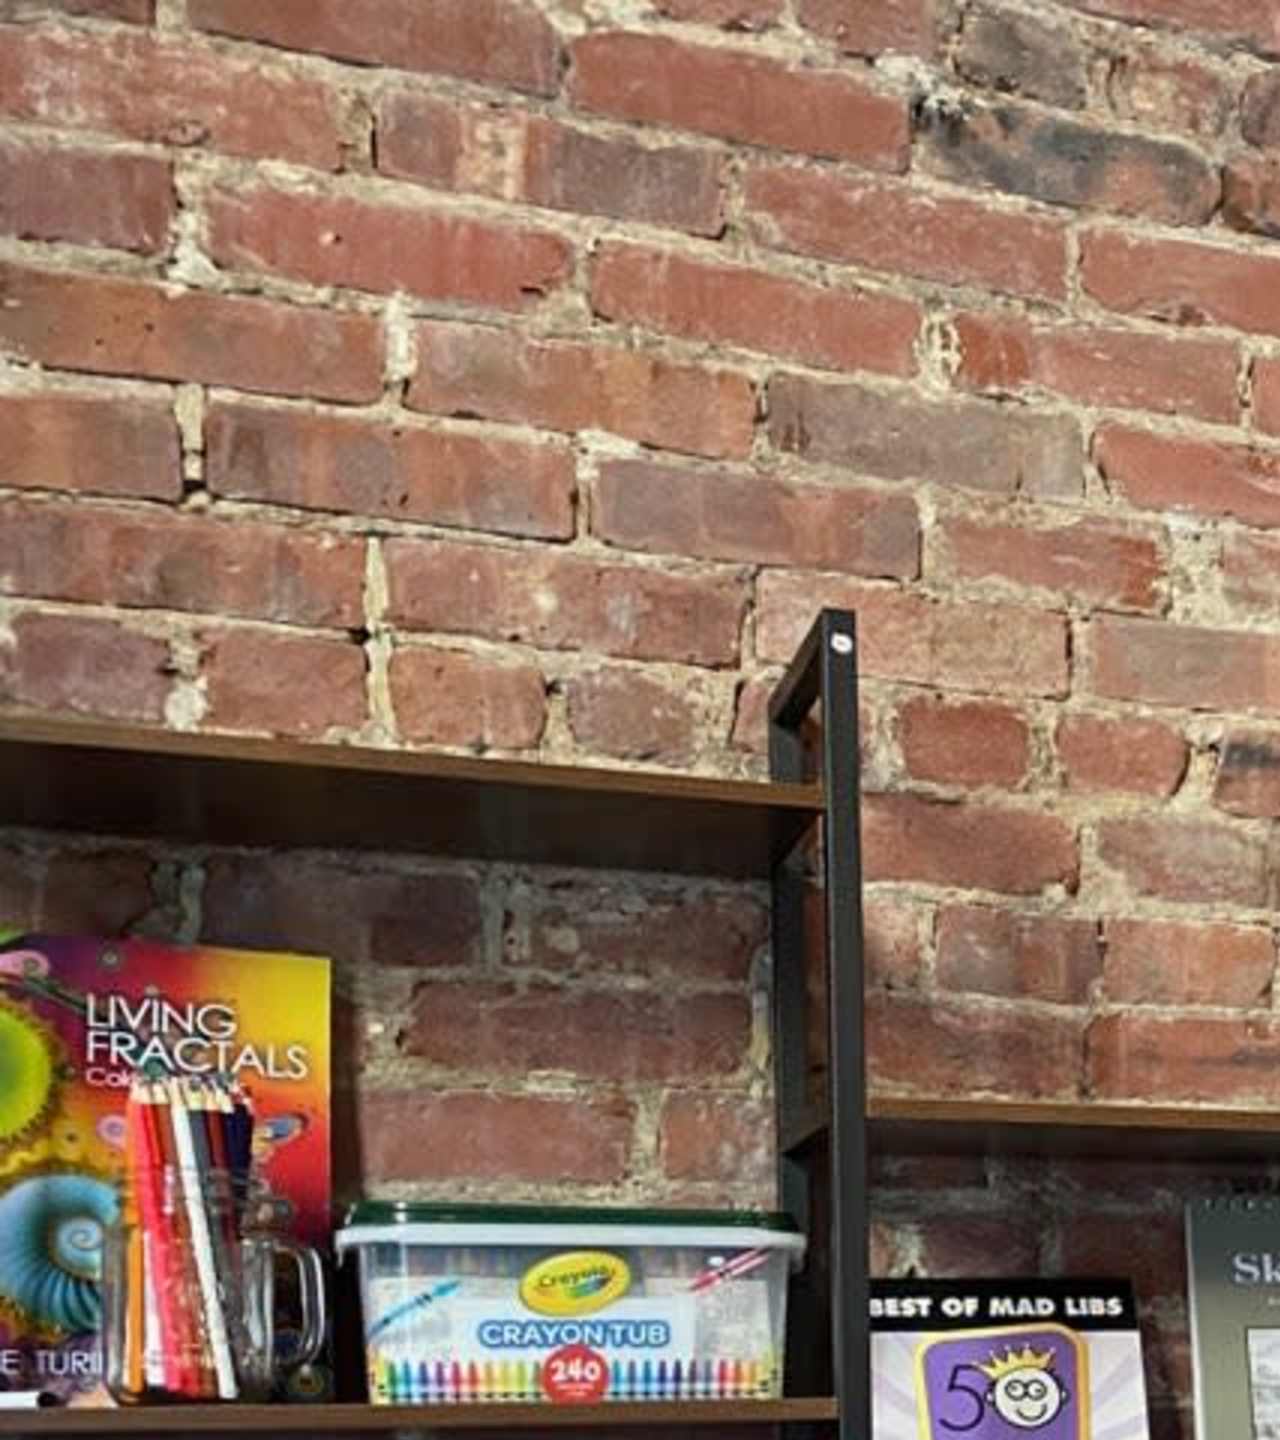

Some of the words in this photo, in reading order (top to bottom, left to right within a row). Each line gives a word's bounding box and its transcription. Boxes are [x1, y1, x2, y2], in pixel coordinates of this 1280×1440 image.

[86, 994, 237, 1038] LIVING
[86, 1030, 308, 1080] FRACTALS
[869, 1297, 932, 1318] BEST
[942, 1297, 978, 1317] OF
[990, 1297, 1055, 1317] MAD
[1065, 1296, 1124, 1316] LIBS
[481, 1321, 604, 1347] CRAYON
[609, 1321, 669, 1346] TUB
[550, 1358, 602, 1382] 240
